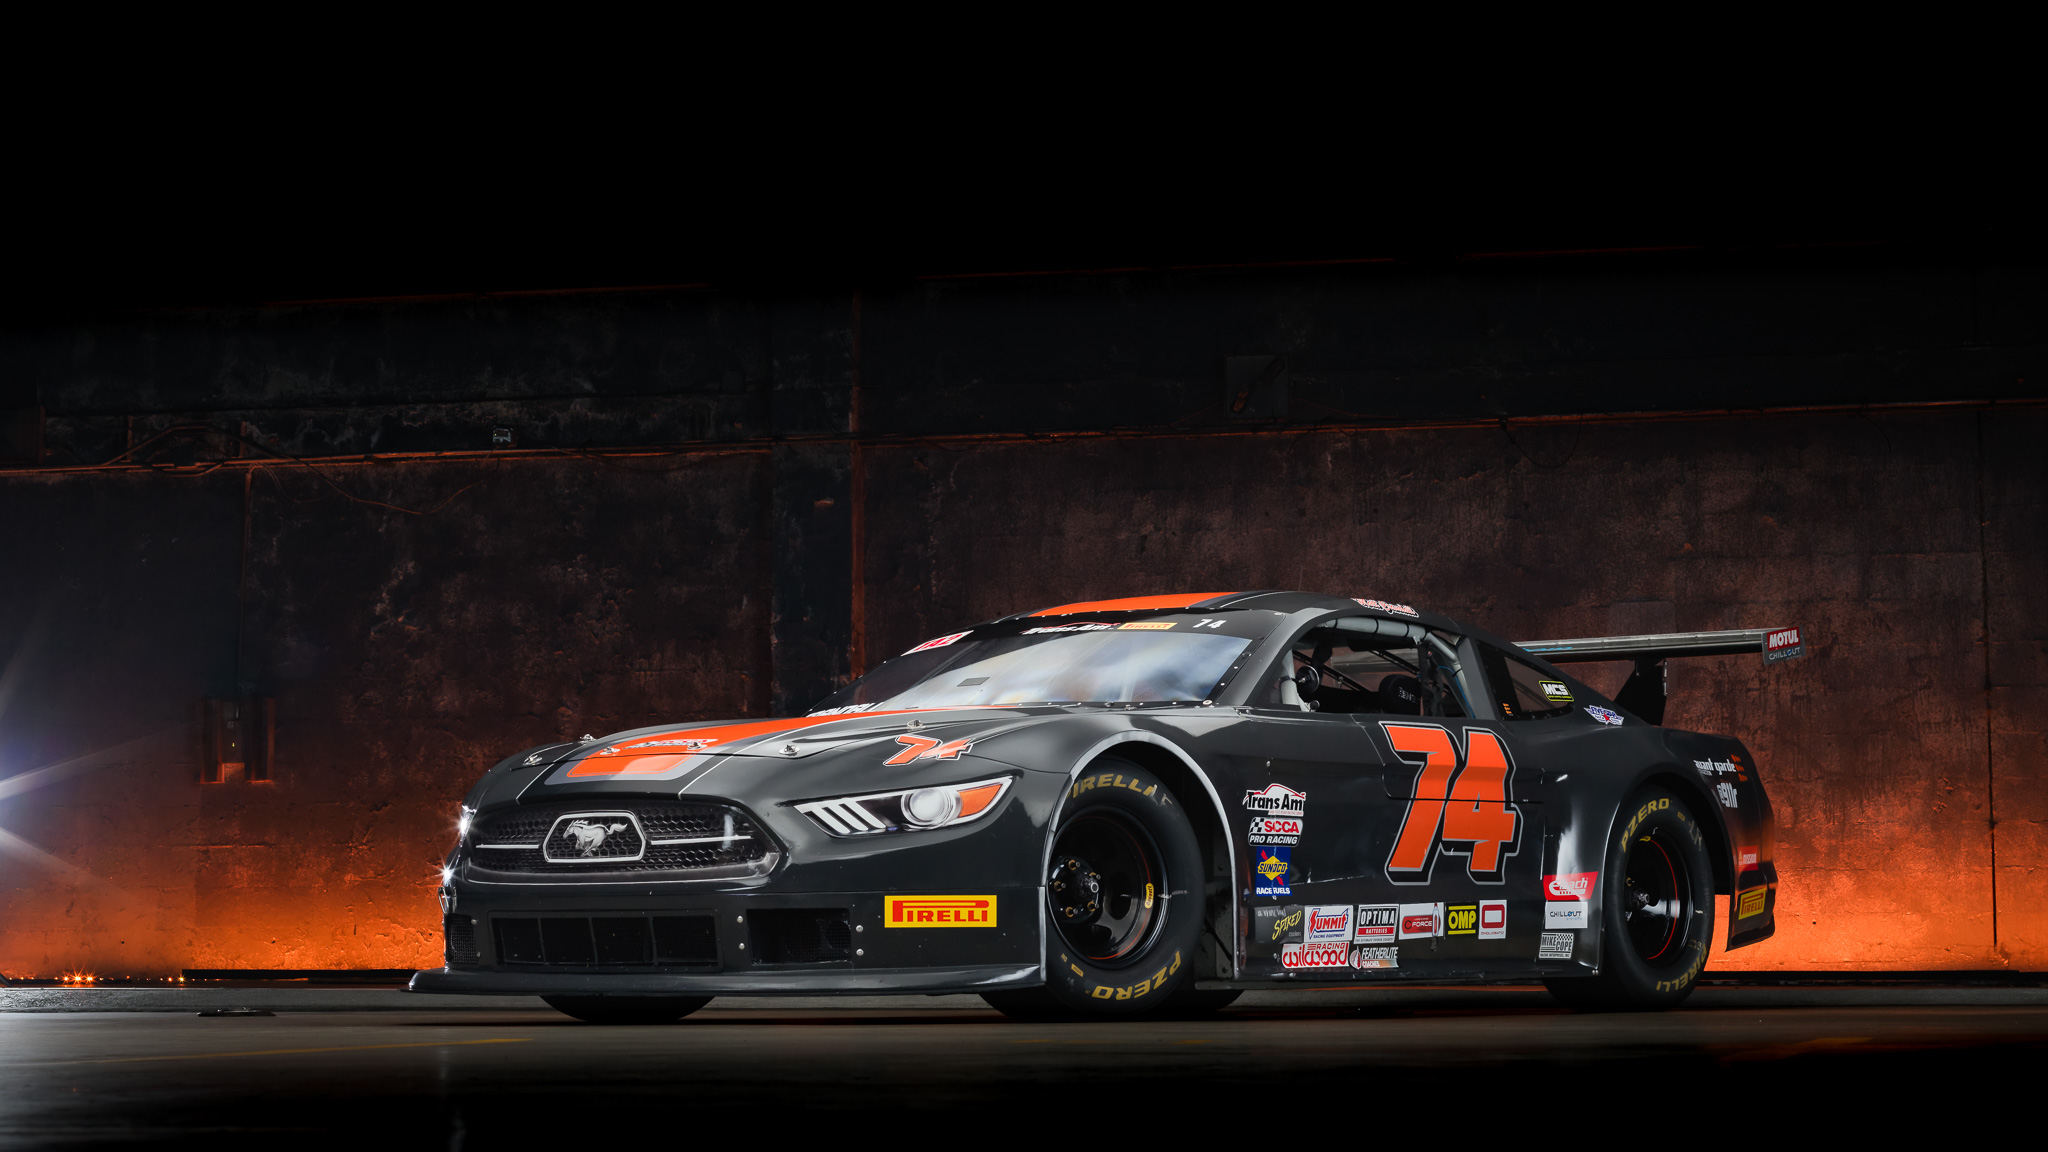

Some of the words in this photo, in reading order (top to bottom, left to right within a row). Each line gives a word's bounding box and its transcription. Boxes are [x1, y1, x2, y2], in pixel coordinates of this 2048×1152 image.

[1193, 618, 1226, 629] 74
[1769, 630, 1799, 648] MOTUL
[1769, 647, 1800, 660] CHILLOUT
[1542, 683, 1569, 695] MCS
[883, 733, 973, 767] 74
[1065, 773, 1157, 799] IRELLI
[1247, 791, 1281, 810] Trans
[1281, 793, 1303, 811] Am
[1378, 721, 1523, 885] 74
[1264, 820, 1300, 833] SCCA
[1249, 835, 1265, 844] PRO
[1266, 836, 1298, 844] RACING
[1258, 863, 1287, 873] SUNOCO
[1256, 887, 1272, 895] RACE
[1273, 887, 1291, 895] FUELS
[892, 900, 990, 922] PIRELLI
[1741, 893, 1764, 915] PIRELLI
[1272, 910, 1302, 940] SPIKED
[1360, 910, 1395, 925] OPTIMA
[1448, 910, 1477, 929] OMP
[1541, 936, 1556, 946] MIKE
[1556, 941, 1572, 951] COPE
[1283, 942, 1349, 967] wilwood
[1361, 947, 1398, 960] FEATHERLITE
